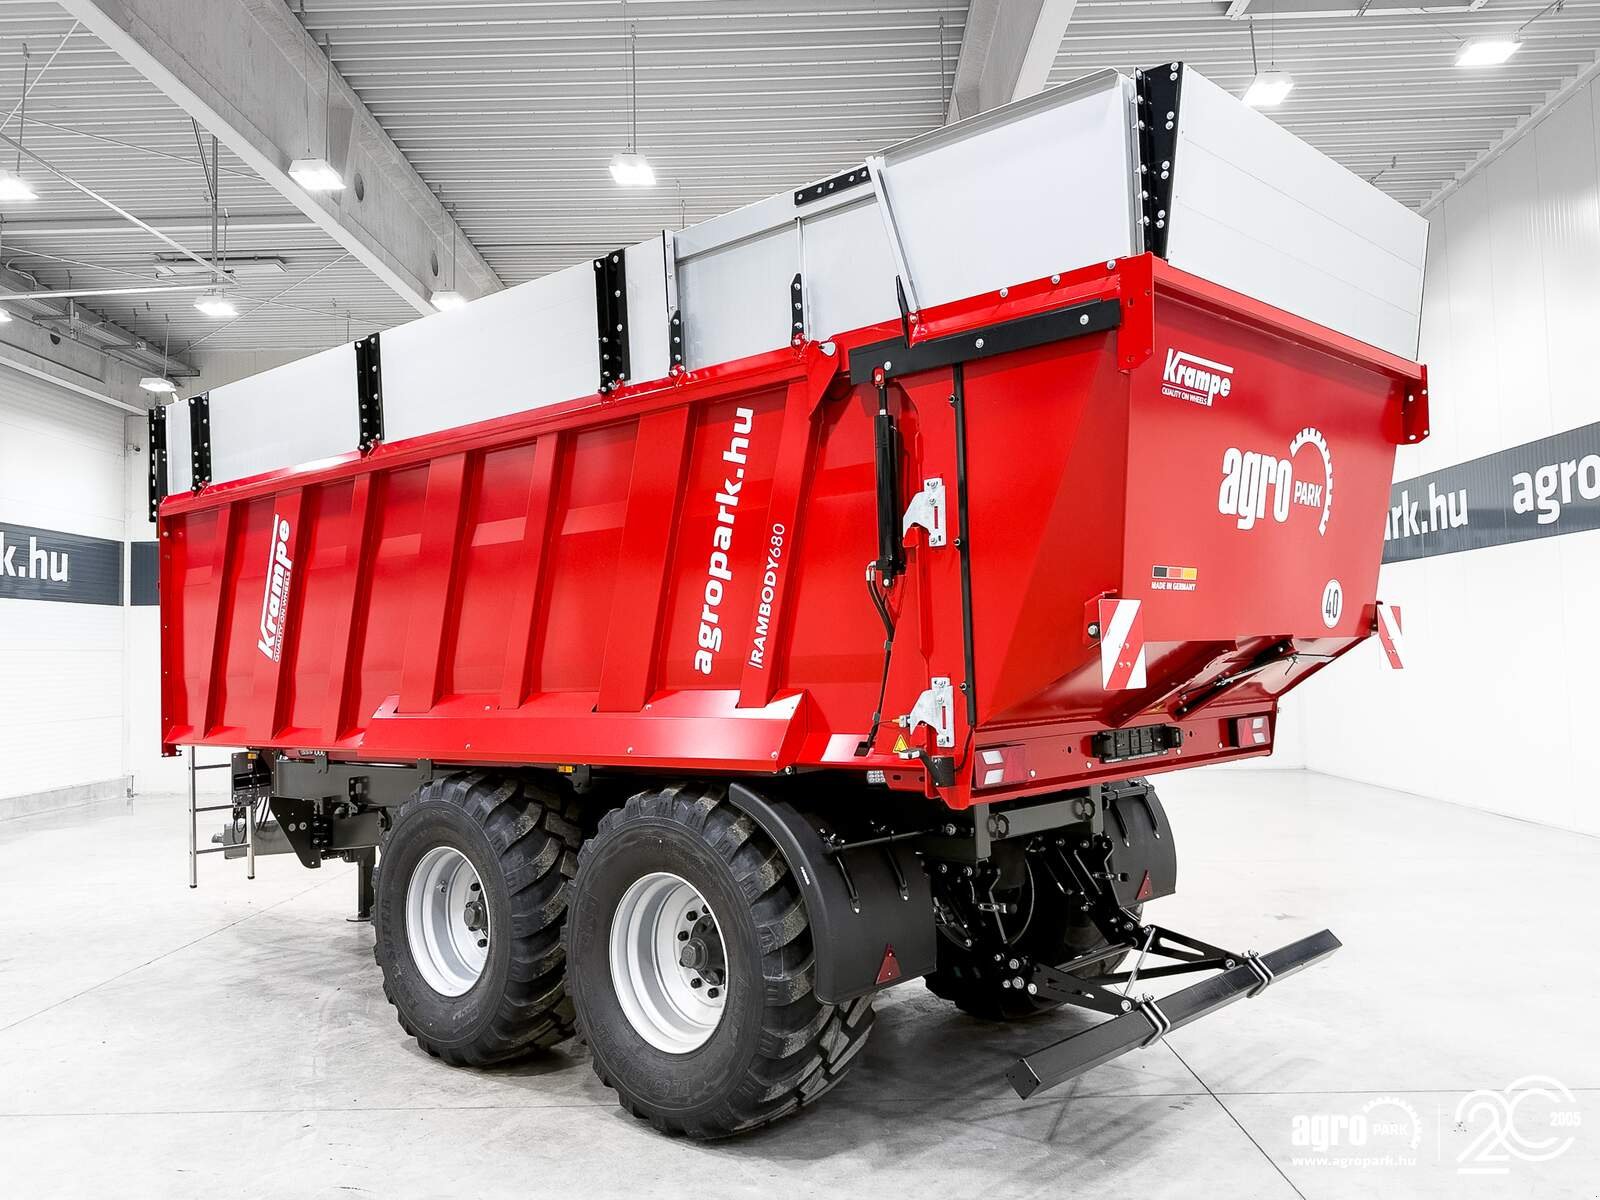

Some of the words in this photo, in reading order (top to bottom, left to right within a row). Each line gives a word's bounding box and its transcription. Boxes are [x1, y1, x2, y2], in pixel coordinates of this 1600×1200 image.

[1161, 386, 1181, 399] QUALITY
[1181, 391, 1190, 401] ON
[1189, 394, 1207, 406] WHEELS
[1163, 347, 1233, 407] Krampe
[1218, 447, 1293, 530] agro
[1294, 480, 1323, 508] PARK
[1385, 482, 1469, 541] rk.hu
[1512, 454, 1600, 525] agro
[694, 407, 754, 675] agropark.hu
[257, 514, 293, 660] Krampe
[1151, 581, 1166, 590] MADE
[1172, 582, 1196, 591] GERMANY
[1325, 588, 1339, 618] 40
